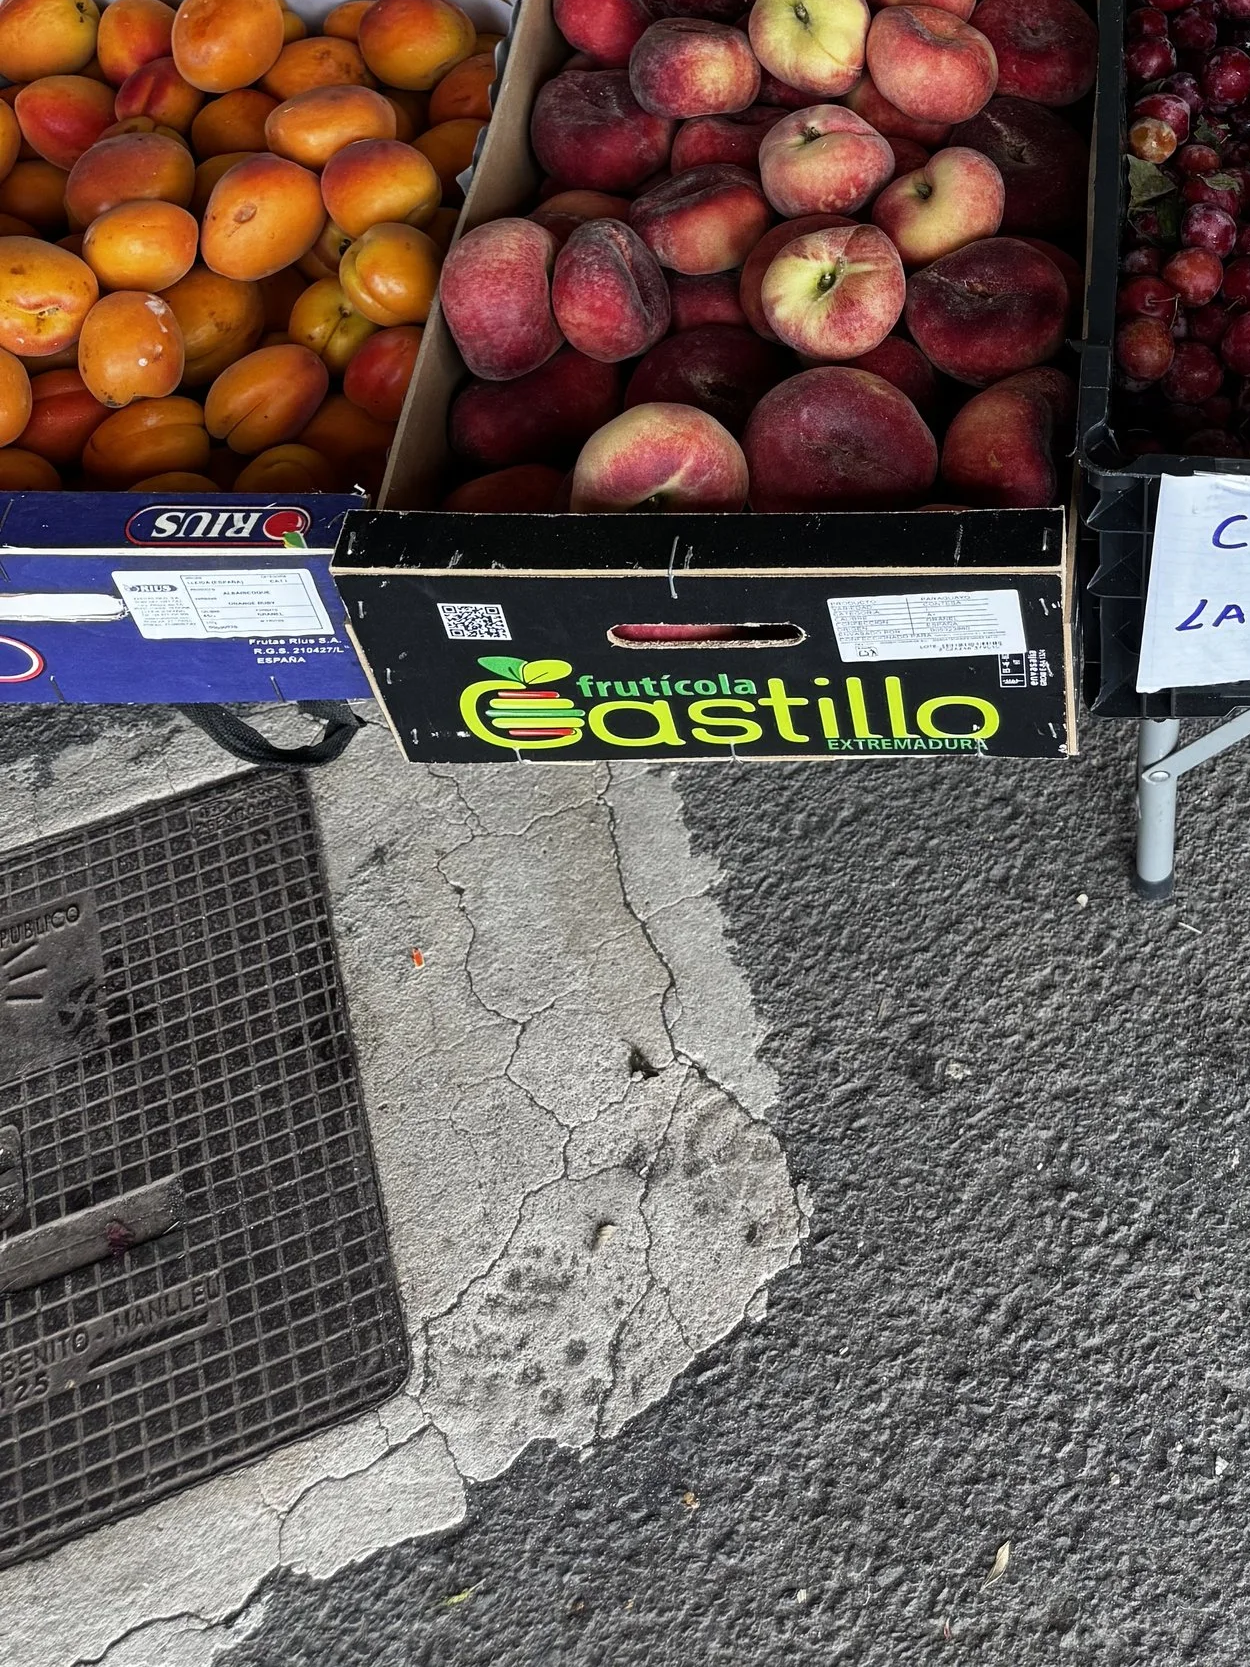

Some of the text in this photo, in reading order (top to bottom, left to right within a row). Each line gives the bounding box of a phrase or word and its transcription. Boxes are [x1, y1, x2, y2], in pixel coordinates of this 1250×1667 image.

[151, 512, 263, 538] RIUS
[249, 638, 286, 646] Frutas
[254, 647, 290, 655] R.G.S.
[257, 656, 306, 664] ESPAÑA
[576, 675, 757, 697] frutícola
[459, 676, 1000, 749] Castillo
[827, 736, 989, 752] EXTREMADURA
